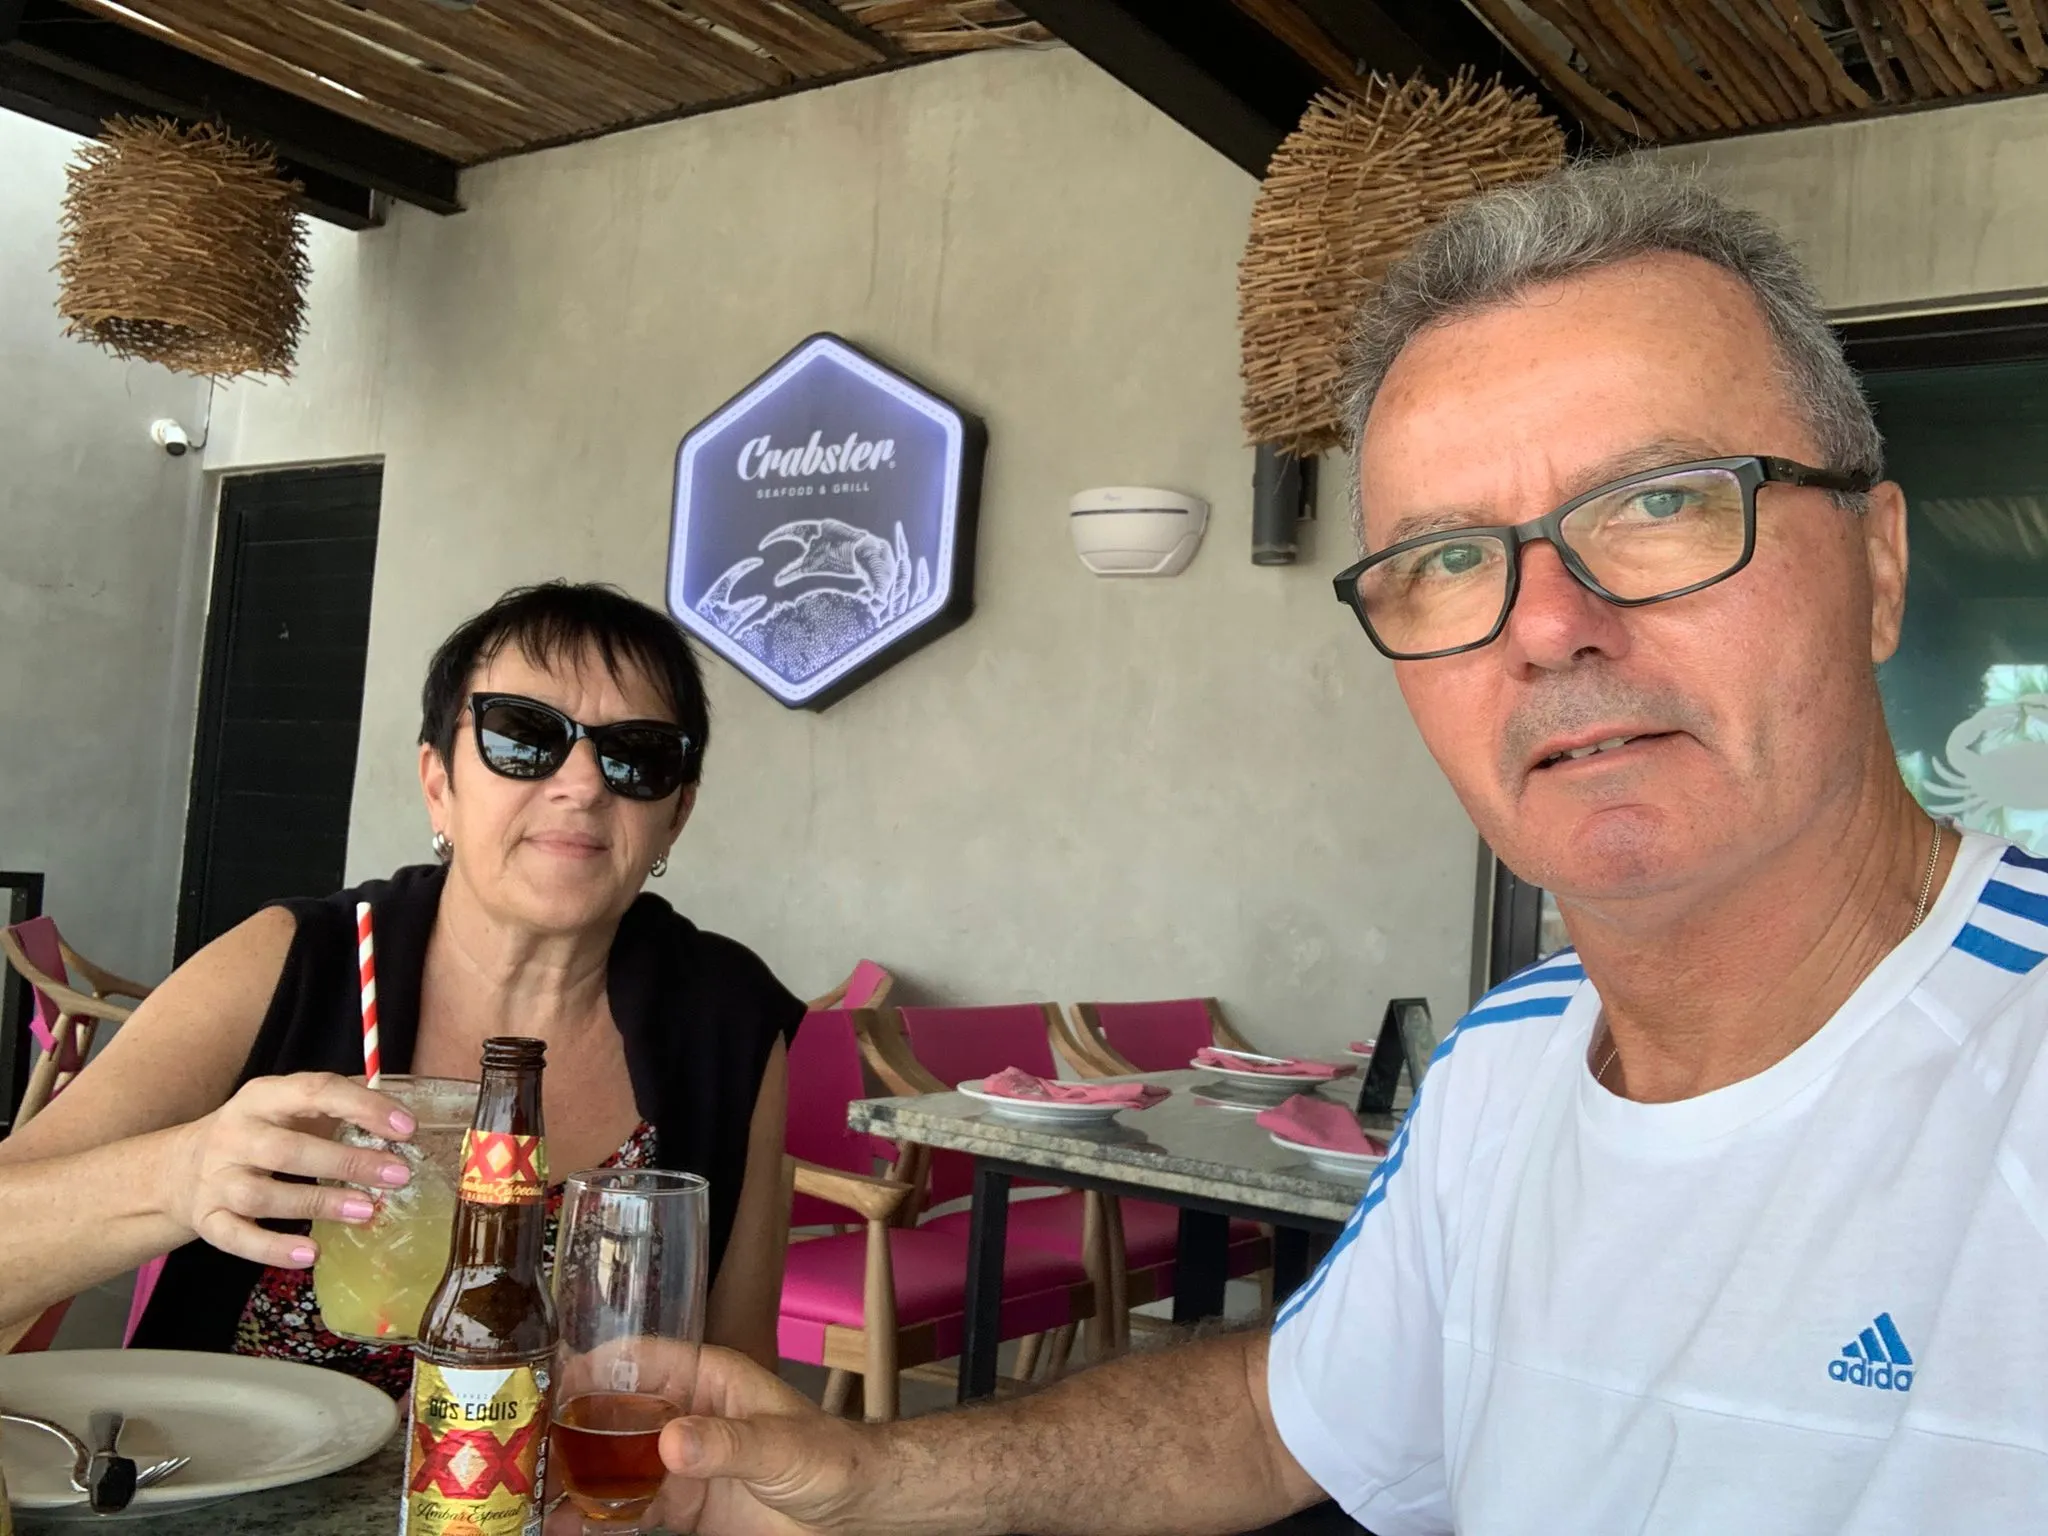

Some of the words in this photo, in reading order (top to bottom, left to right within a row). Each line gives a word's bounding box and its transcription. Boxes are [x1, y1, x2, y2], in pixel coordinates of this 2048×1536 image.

[737, 430, 895, 481] Crabster
[756, 486, 814, 499] SEAFOOD
[819, 485, 827, 495] &
[833, 481, 870, 494] GRILL
[1827, 1358, 1914, 1392] adida
[430, 1398, 461, 1420] DOS
[465, 1401, 518, 1422] EQUIS
[415, 1502, 468, 1521] Ambar
[466, 1500, 527, 1526] Especial
